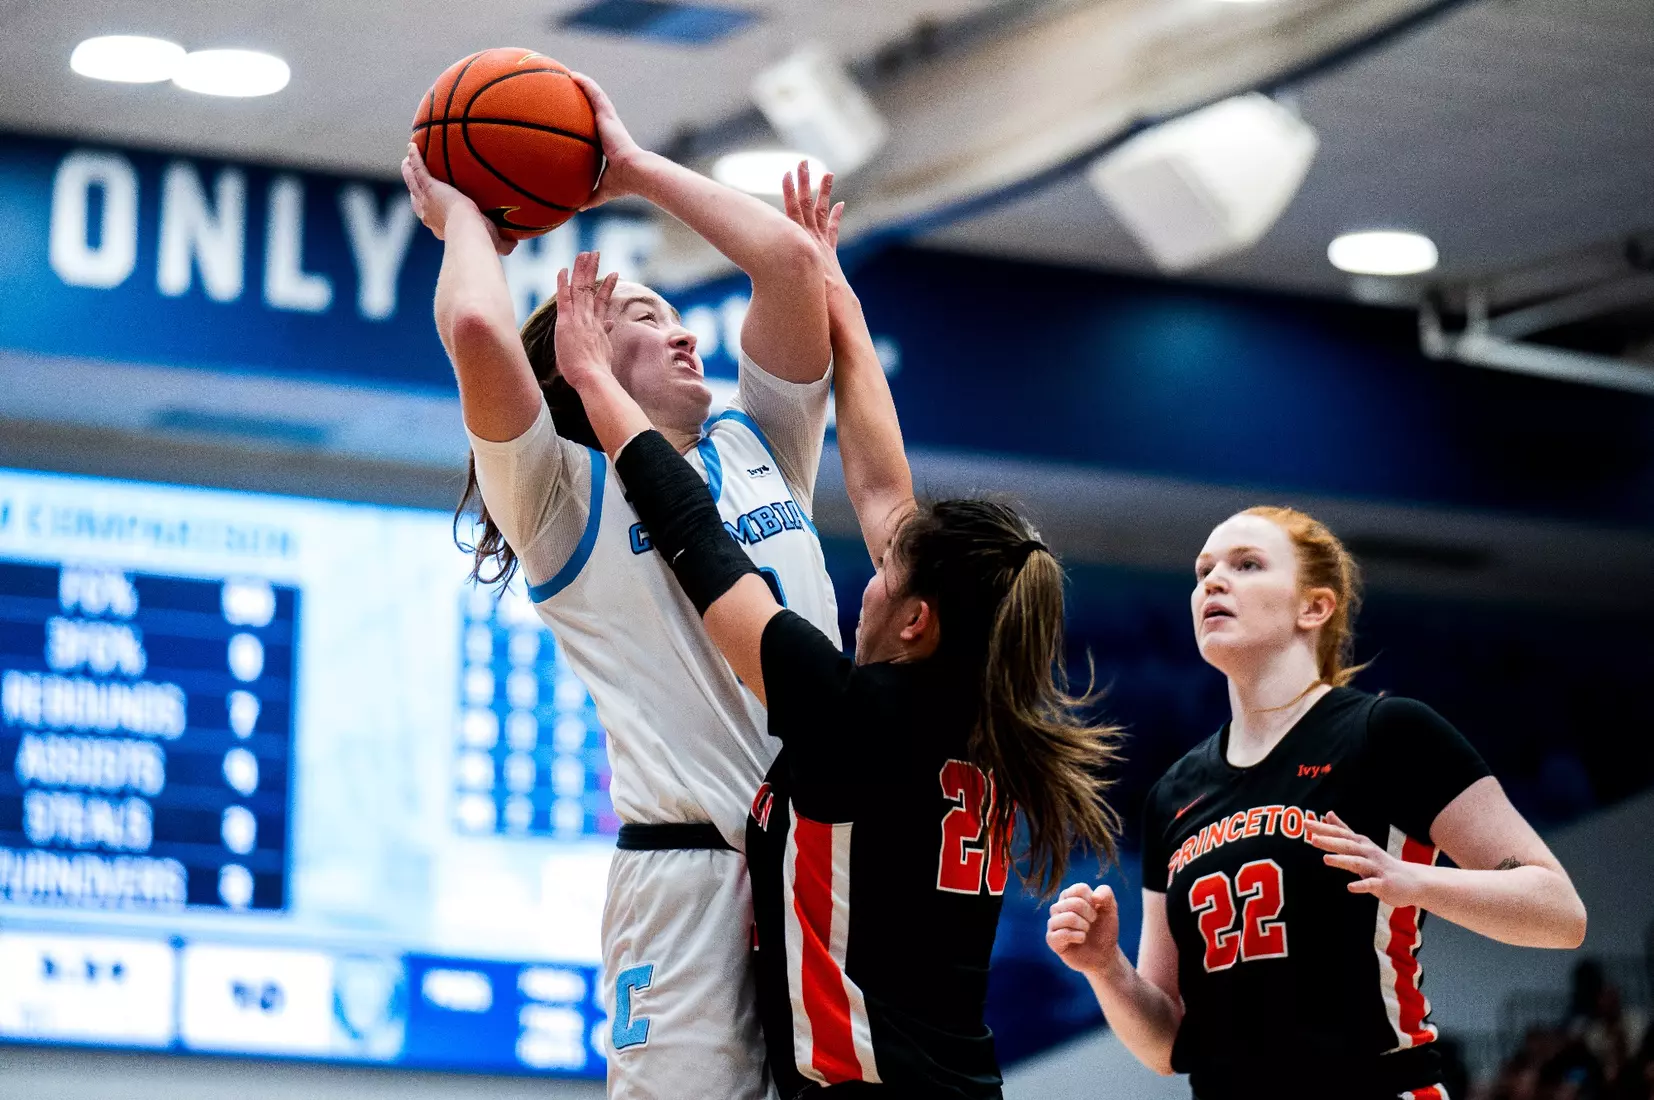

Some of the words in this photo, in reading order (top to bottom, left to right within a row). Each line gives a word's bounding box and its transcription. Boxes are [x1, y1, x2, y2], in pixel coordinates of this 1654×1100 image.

[49, 150, 420, 320] ONLY
[628, 500, 804, 556] CMBIA
[1297, 764, 1321, 779] Ivy
[1189, 858, 1288, 973] 22
[612, 962, 655, 1053] C
